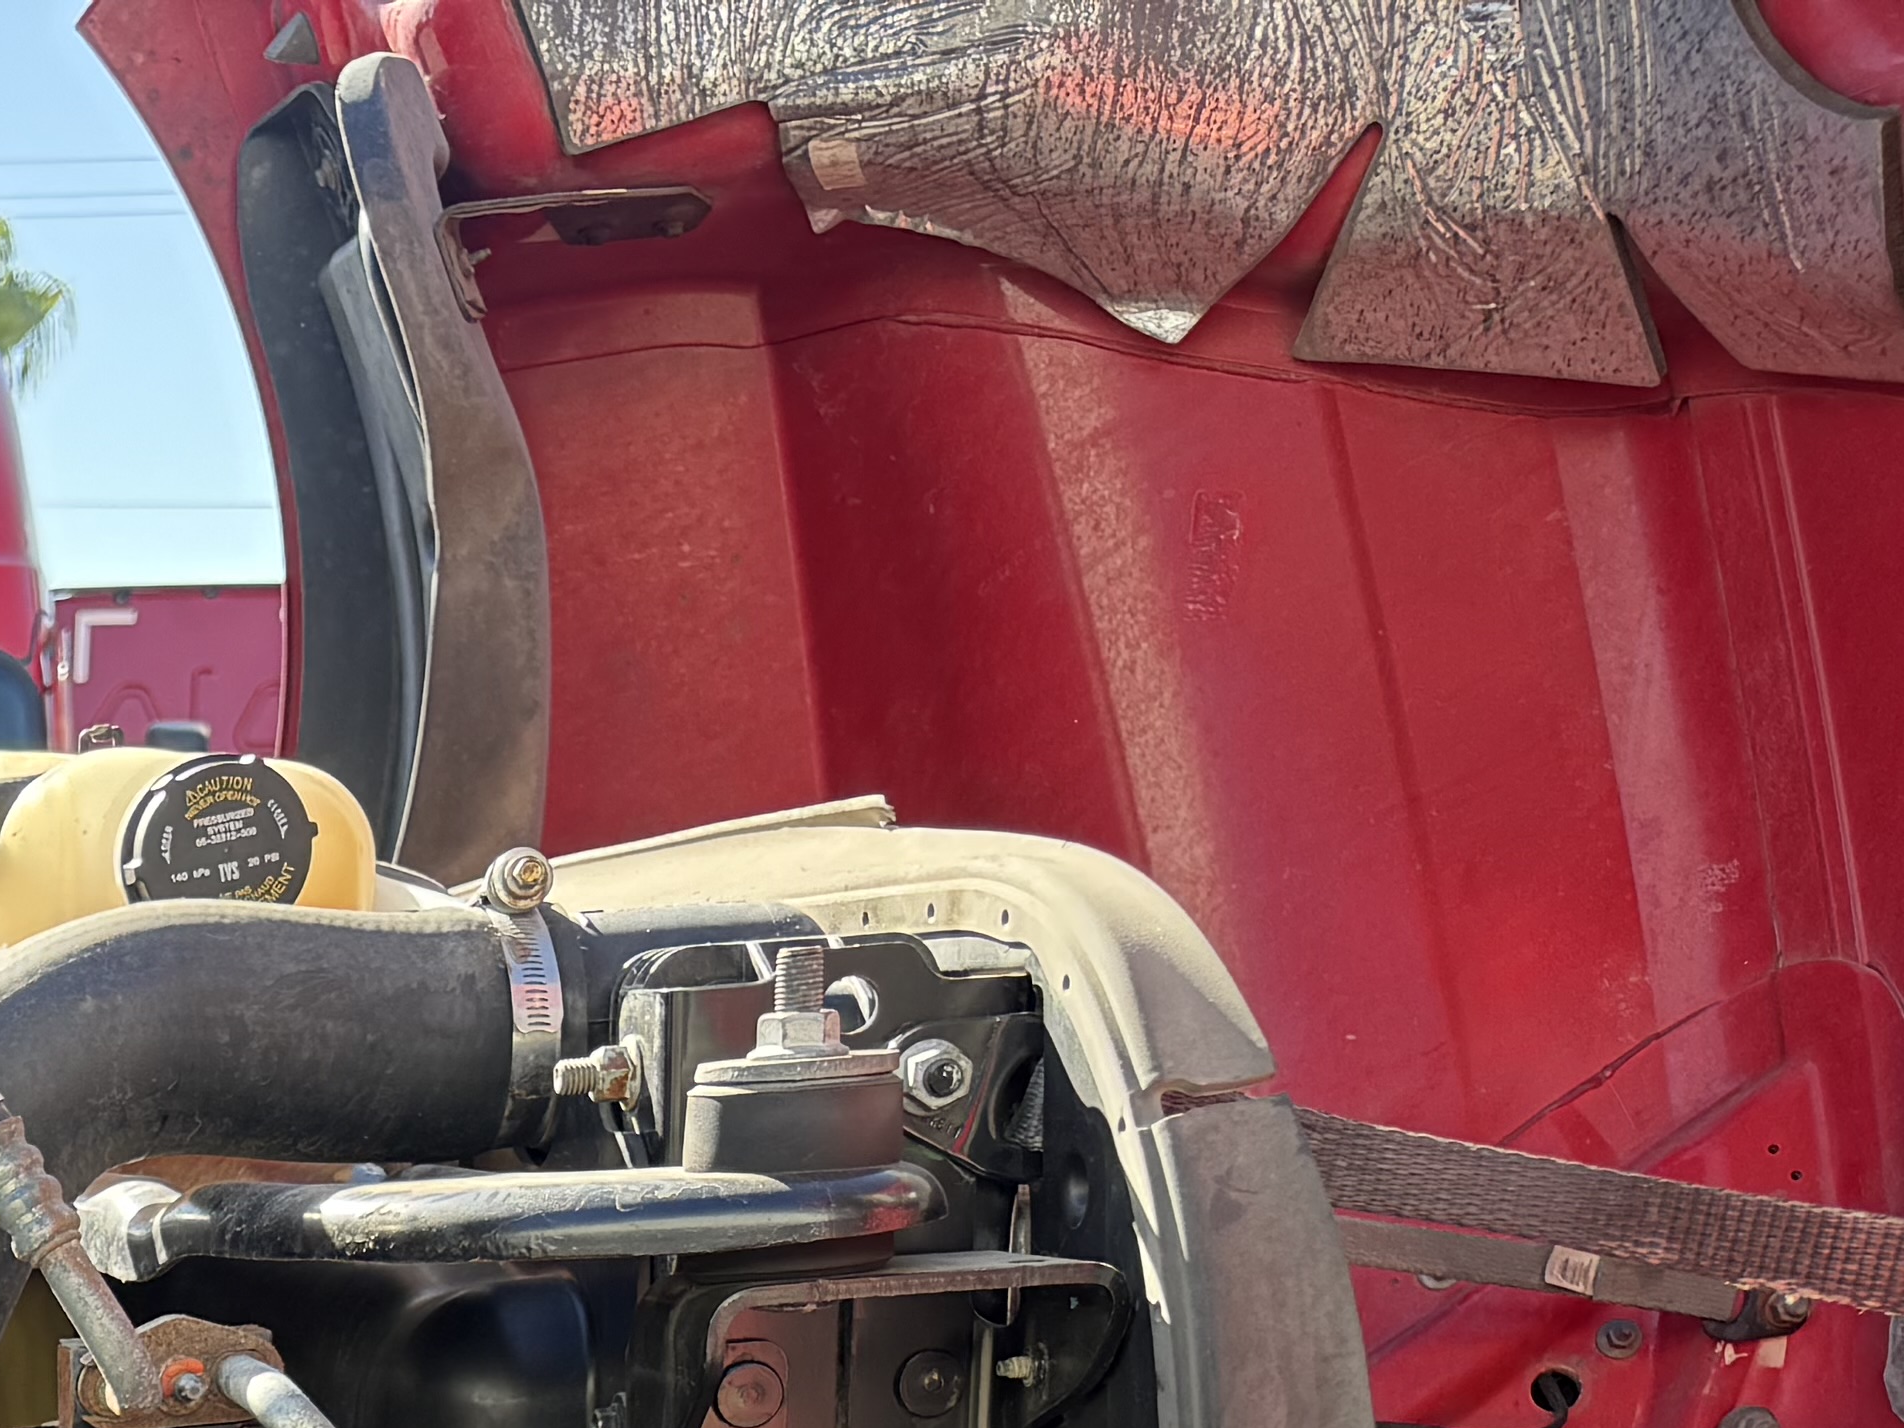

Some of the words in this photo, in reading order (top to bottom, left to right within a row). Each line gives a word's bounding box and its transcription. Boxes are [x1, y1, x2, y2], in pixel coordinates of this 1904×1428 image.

[196, 776, 253, 797] CAUTION
[193, 807, 255, 828] PRESSURIZED
[207, 820, 243, 835] SYSTEM
[218, 861, 240, 882] TVS
